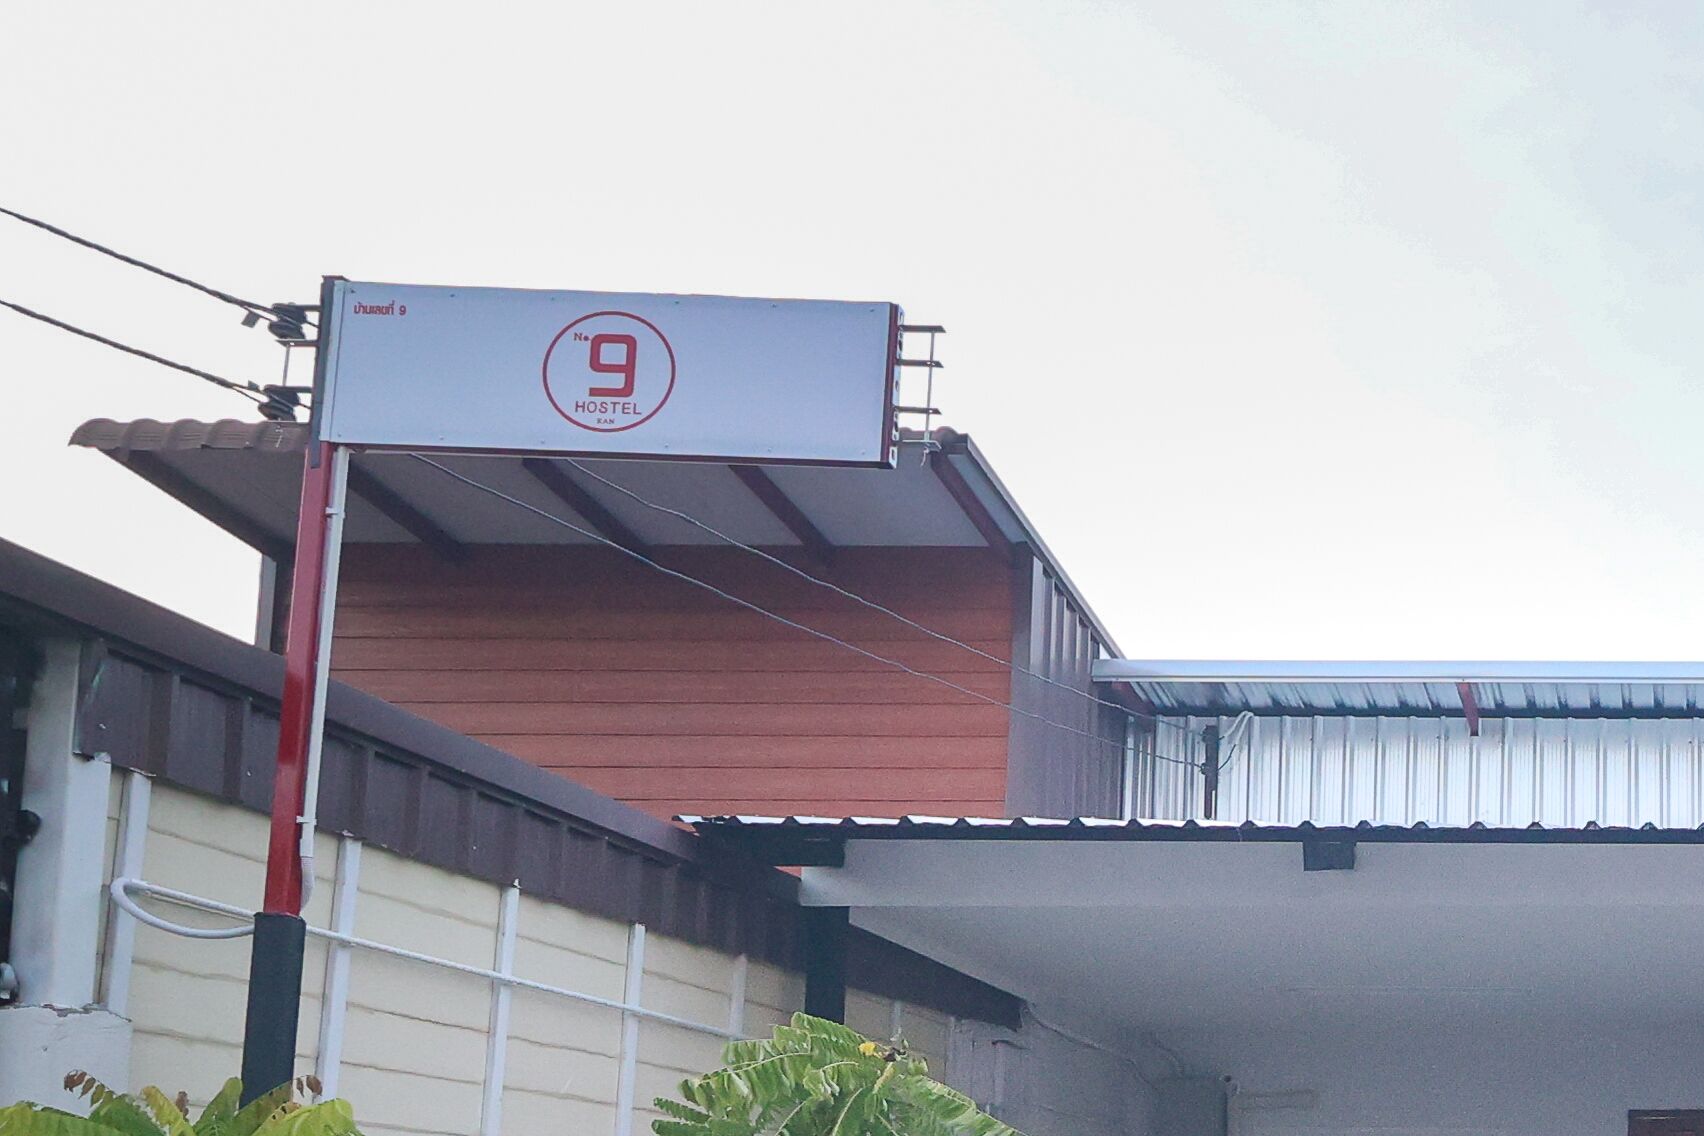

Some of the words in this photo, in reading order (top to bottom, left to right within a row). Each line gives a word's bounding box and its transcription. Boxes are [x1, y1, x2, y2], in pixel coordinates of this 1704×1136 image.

[399, 305, 406, 315] 9
[588, 333, 637, 397] 9
[575, 401, 641, 415] HOSTEL
